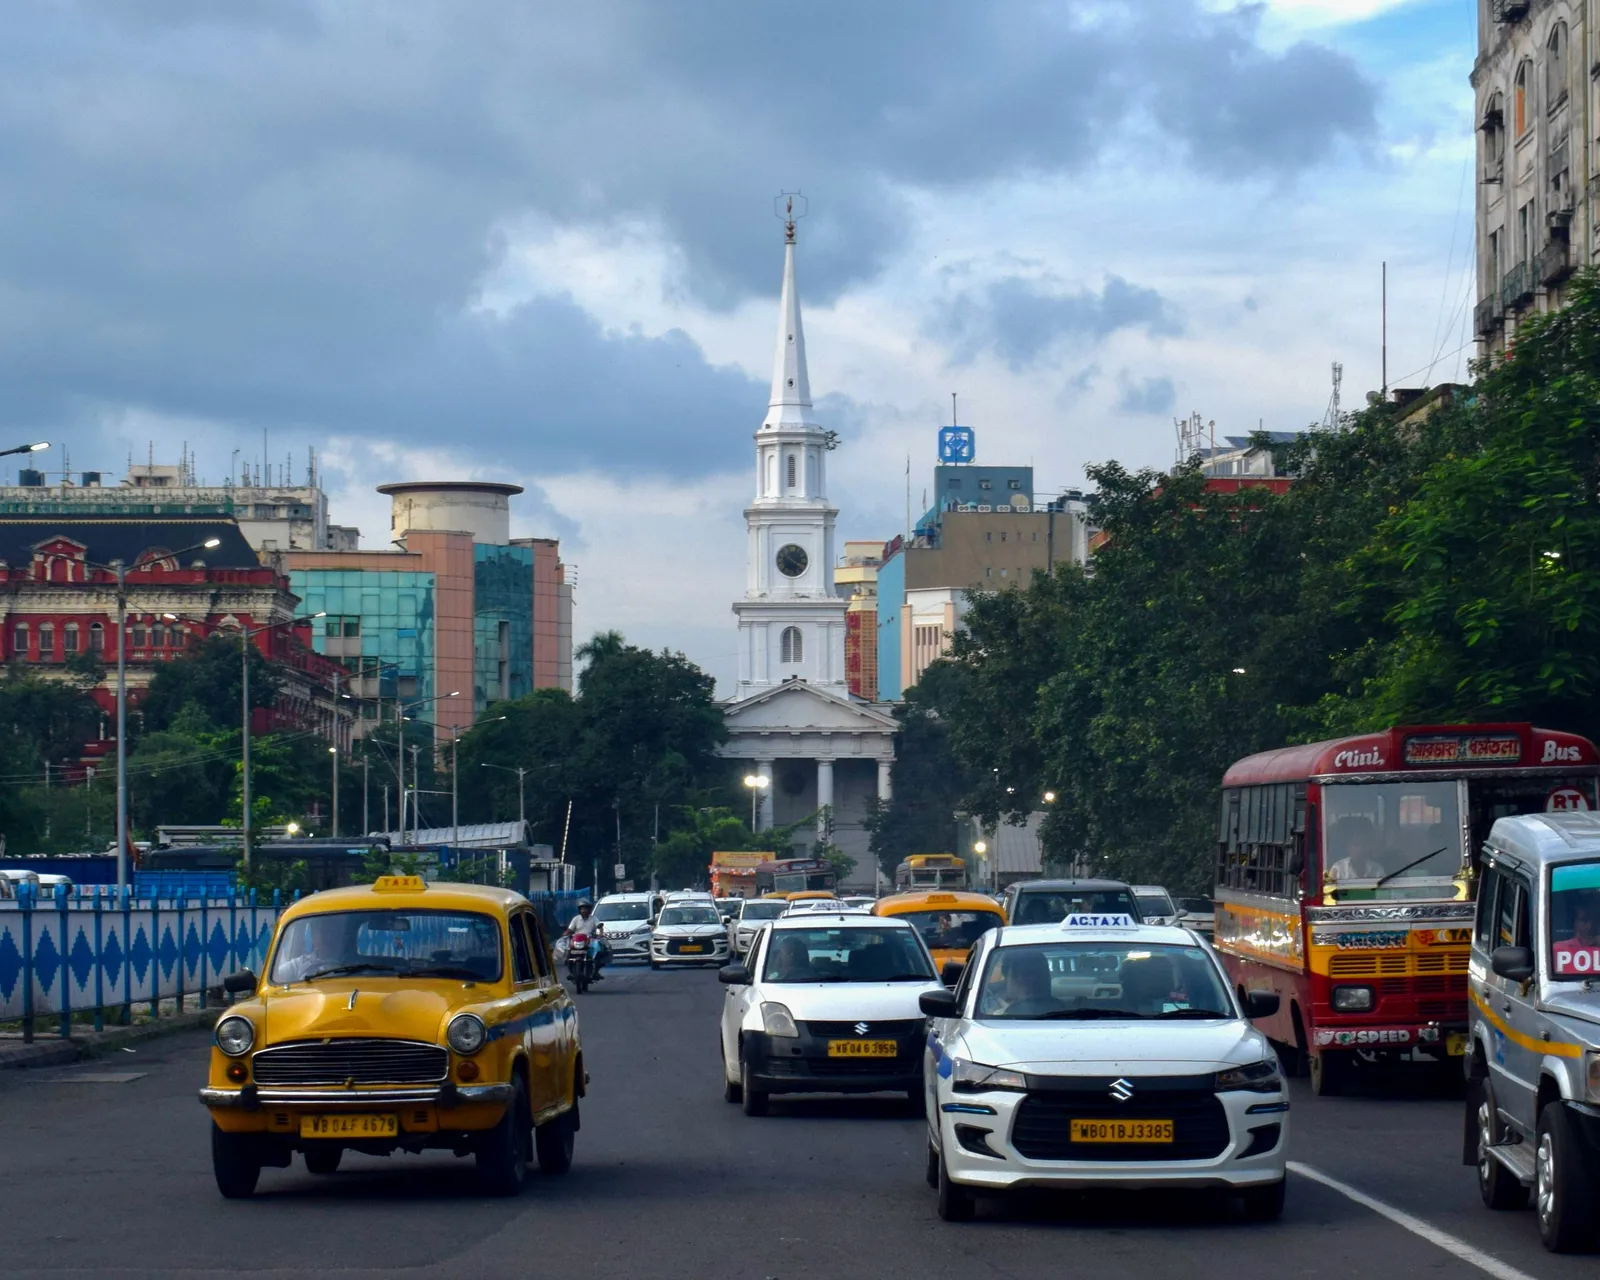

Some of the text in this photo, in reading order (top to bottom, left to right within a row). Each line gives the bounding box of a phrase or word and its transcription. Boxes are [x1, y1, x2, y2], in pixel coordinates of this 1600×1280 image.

[1541, 740, 1582, 763] Bus
[1553, 794, 1580, 809] RT
[383, 878, 417, 886] TAXI
[1448, 929, 1472, 941] TA
[1357, 1030, 1410, 1044] SPEED
